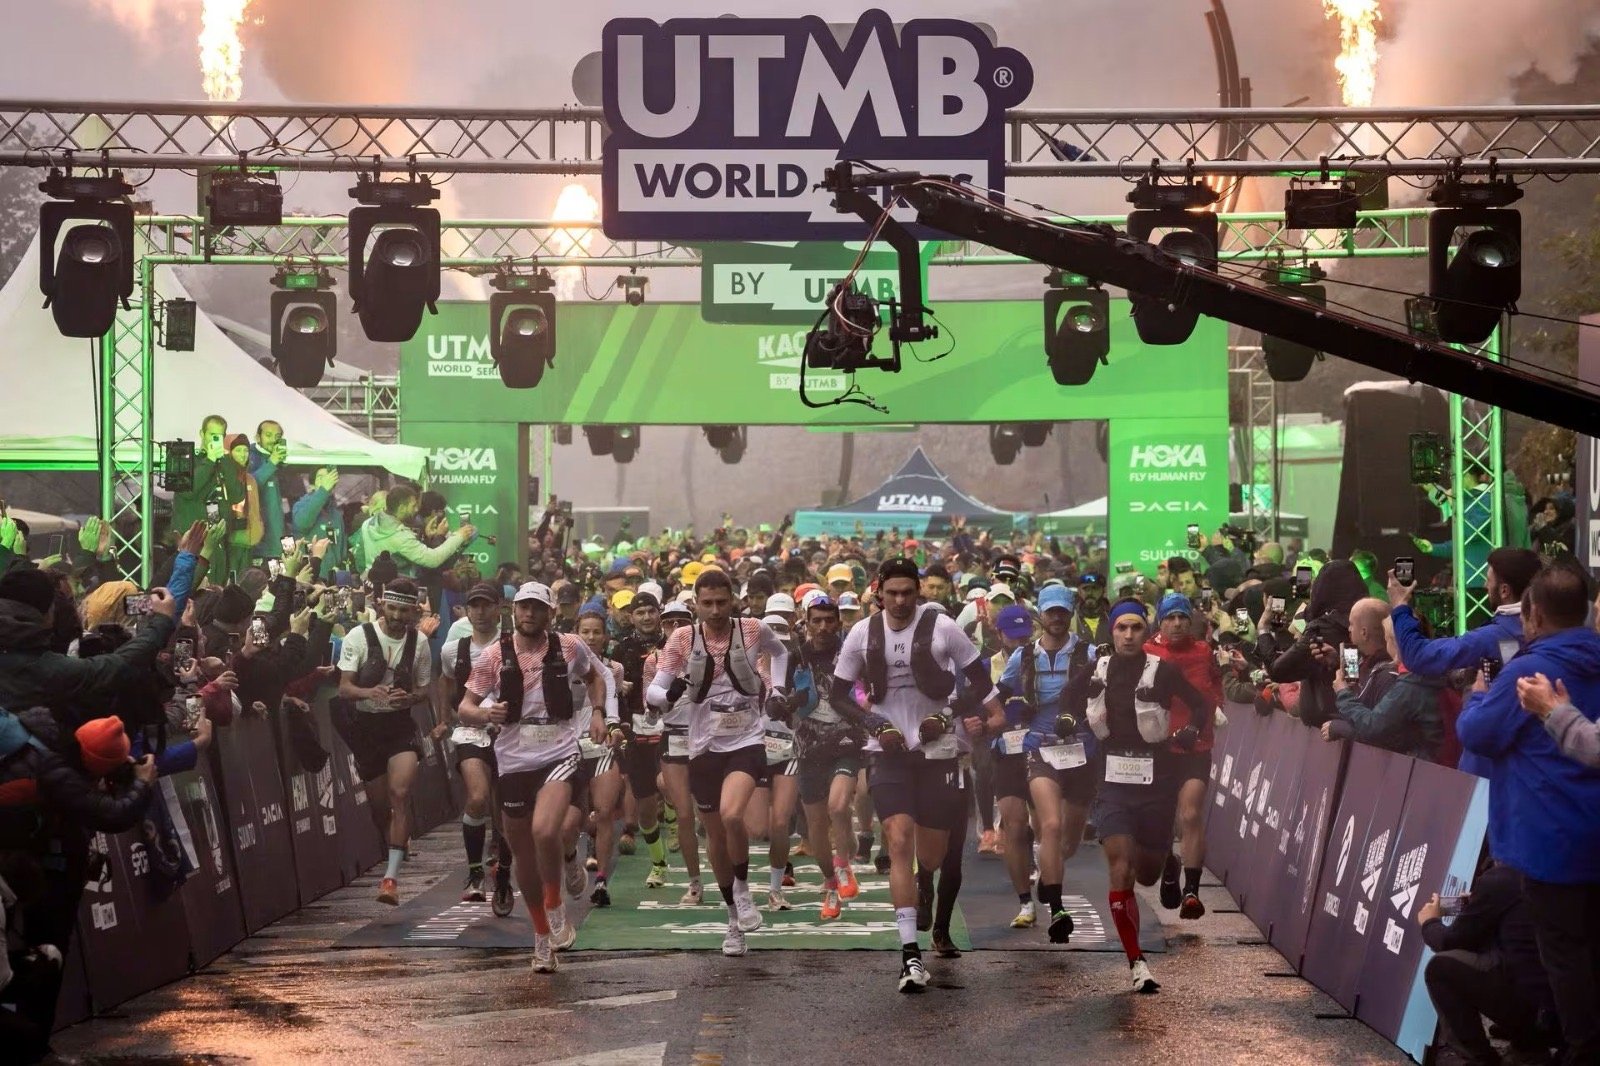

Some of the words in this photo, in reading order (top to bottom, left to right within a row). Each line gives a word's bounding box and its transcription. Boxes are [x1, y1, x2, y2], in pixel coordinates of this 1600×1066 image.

[634, 163, 808, 198] WORLD
[731, 272, 764, 294] BY
[428, 334, 497, 360] UTM
[432, 364, 472, 373] WORLD
[1129, 444, 1207, 468] HOKA
[439, 475, 479, 484] HUMAN
[480, 475, 497, 484] FLY
[1129, 472, 1146, 482] FLY
[1148, 472, 1188, 481] HUMAN
[1189, 472, 1207, 481] FLY
[879, 493, 944, 506] UTMB
[1129, 501, 1208, 512] DACIA
